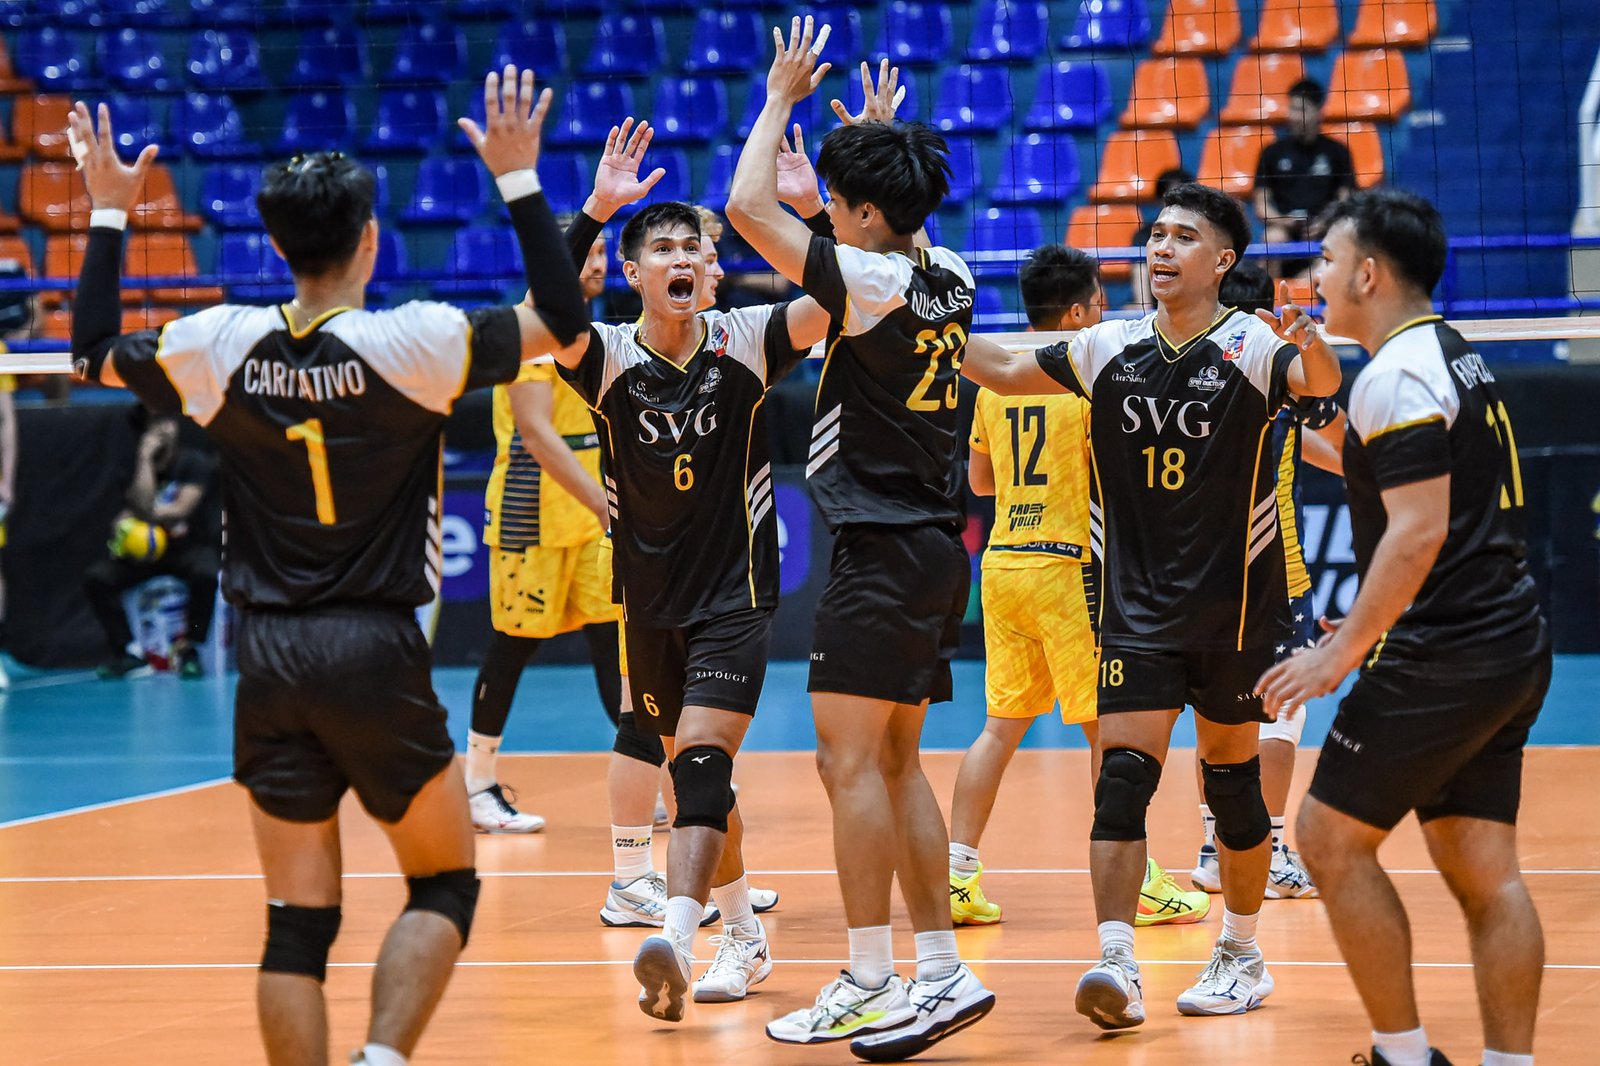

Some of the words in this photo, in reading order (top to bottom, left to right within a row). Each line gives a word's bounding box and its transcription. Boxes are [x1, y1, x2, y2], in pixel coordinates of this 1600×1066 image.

[638, 401, 717, 444] SVG
[1121, 394, 1211, 438] SVG
[1005, 405, 1048, 487] 12
[285, 417, 336, 525] 1
[673, 453, 695, 491] 6
[1141, 446, 1186, 491] 18
[1008, 503, 1031, 518] PRO
[1009, 515, 1042, 532] VOLLEY
[1100, 658, 1124, 688] 18
[642, 692, 660, 717] 6
